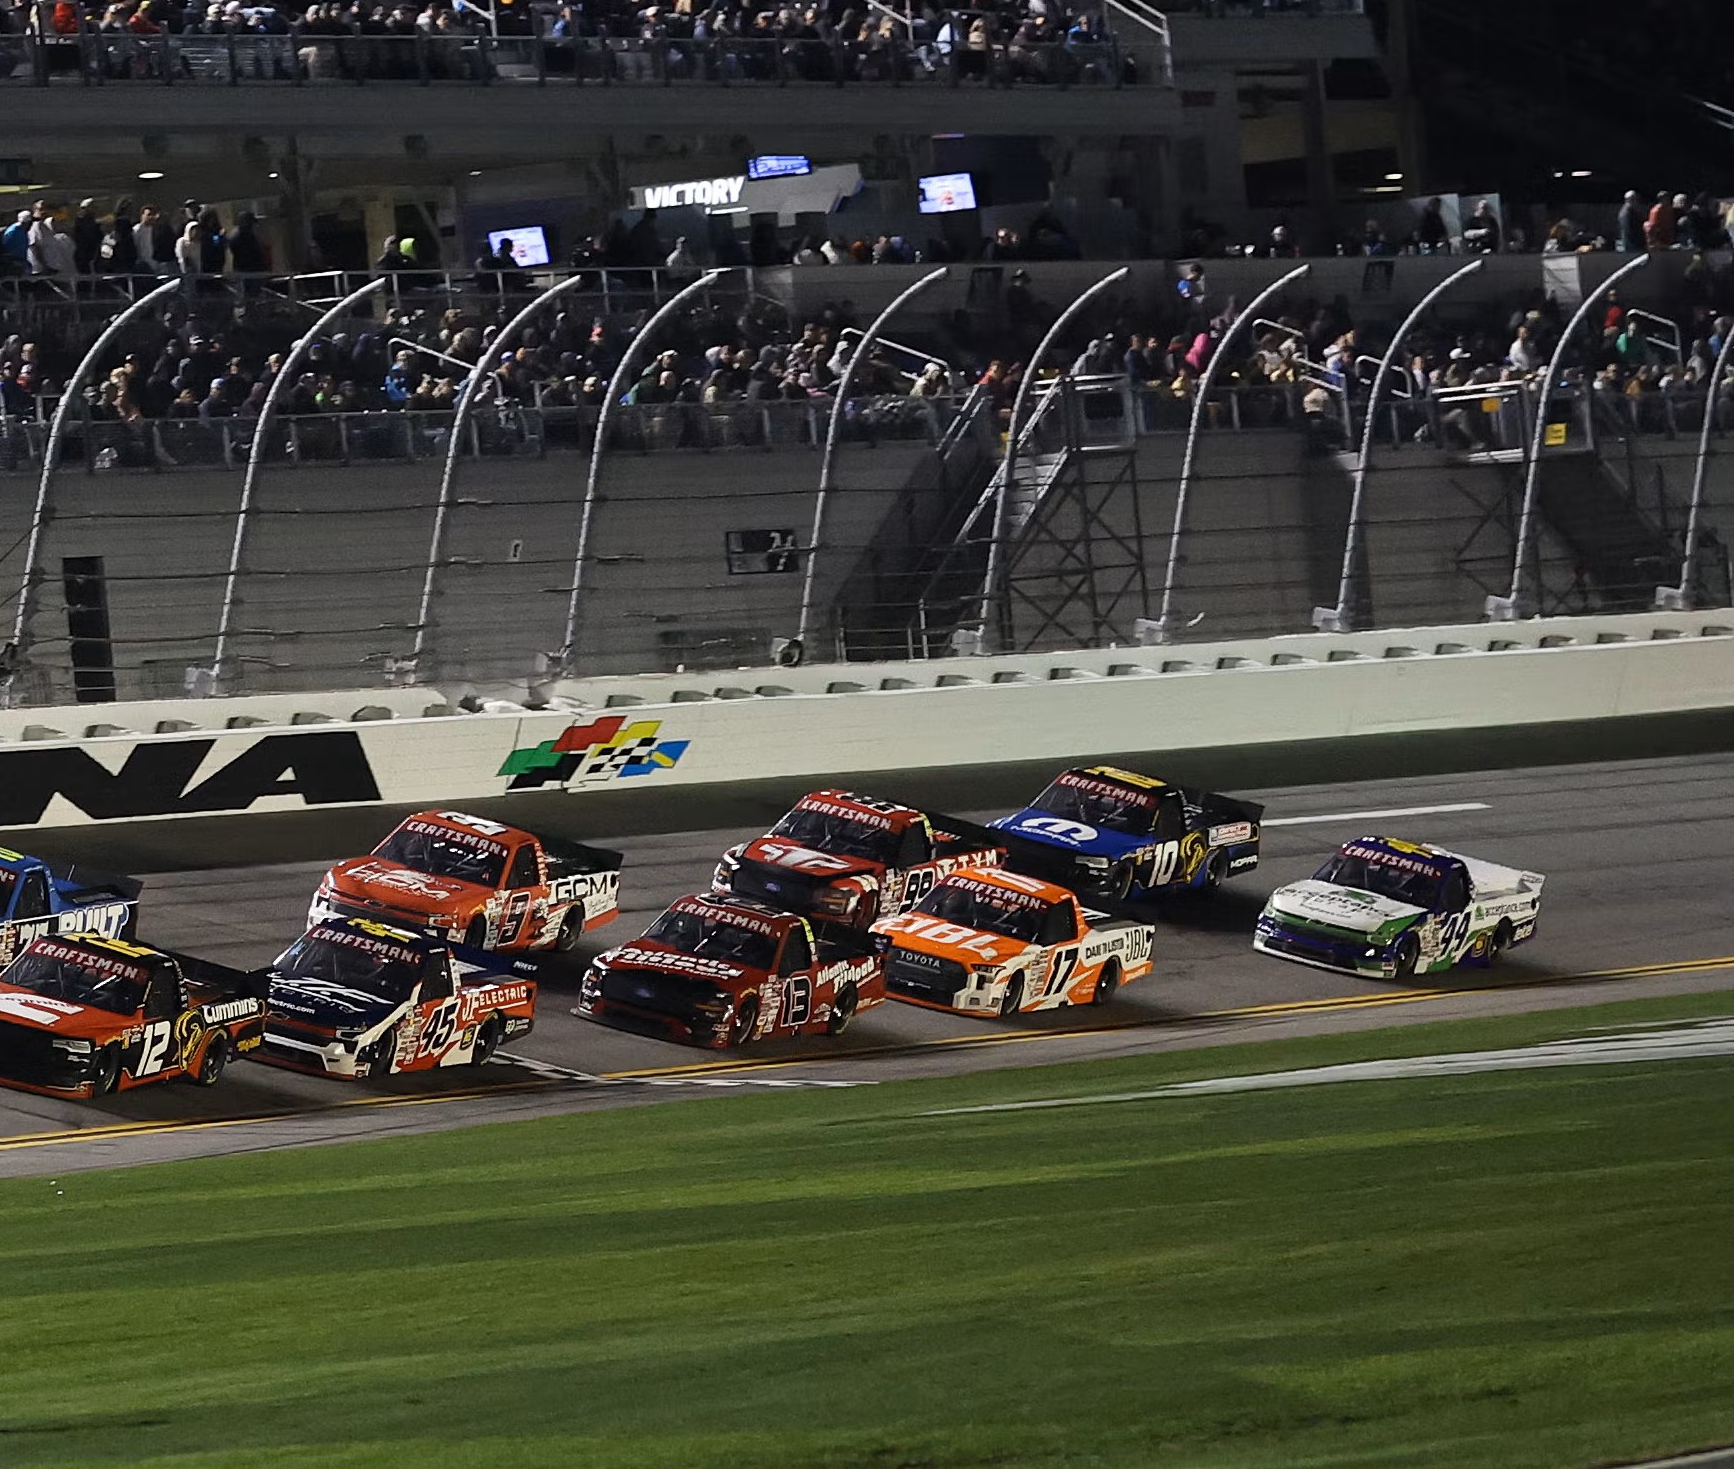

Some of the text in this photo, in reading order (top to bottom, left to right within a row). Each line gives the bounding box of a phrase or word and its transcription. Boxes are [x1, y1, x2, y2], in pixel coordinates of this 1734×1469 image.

[644, 176, 745, 209] VICTORY
[1061, 775, 1148, 806] CRAFTSMAN
[802, 799, 892, 830] CRAFTSMAN
[405, 820, 502, 857] CRAFTSMAN
[1149, 841, 1179, 888] 10
[1344, 845, 1434, 877] CRAFTSMAN
[556, 873, 608, 903] GCM
[947, 876, 1040, 910] CRAFTSMAN
[499, 893, 530, 944] 9
[676, 902, 773, 934] CRAFTSMAN
[1440, 911, 1472, 956] 44
[35, 942, 138, 979] CRAFTSMAN
[312, 927, 414, 965] CRAFTSMAN
[900, 950, 941, 969] TOYOTA
[1126, 928, 1148, 962] JBL
[1044, 946, 1080, 996] 17
[479, 985, 527, 1006] ELECTRIC
[420, 1006, 457, 1055] 45
[136, 1020, 172, 1077] 12
